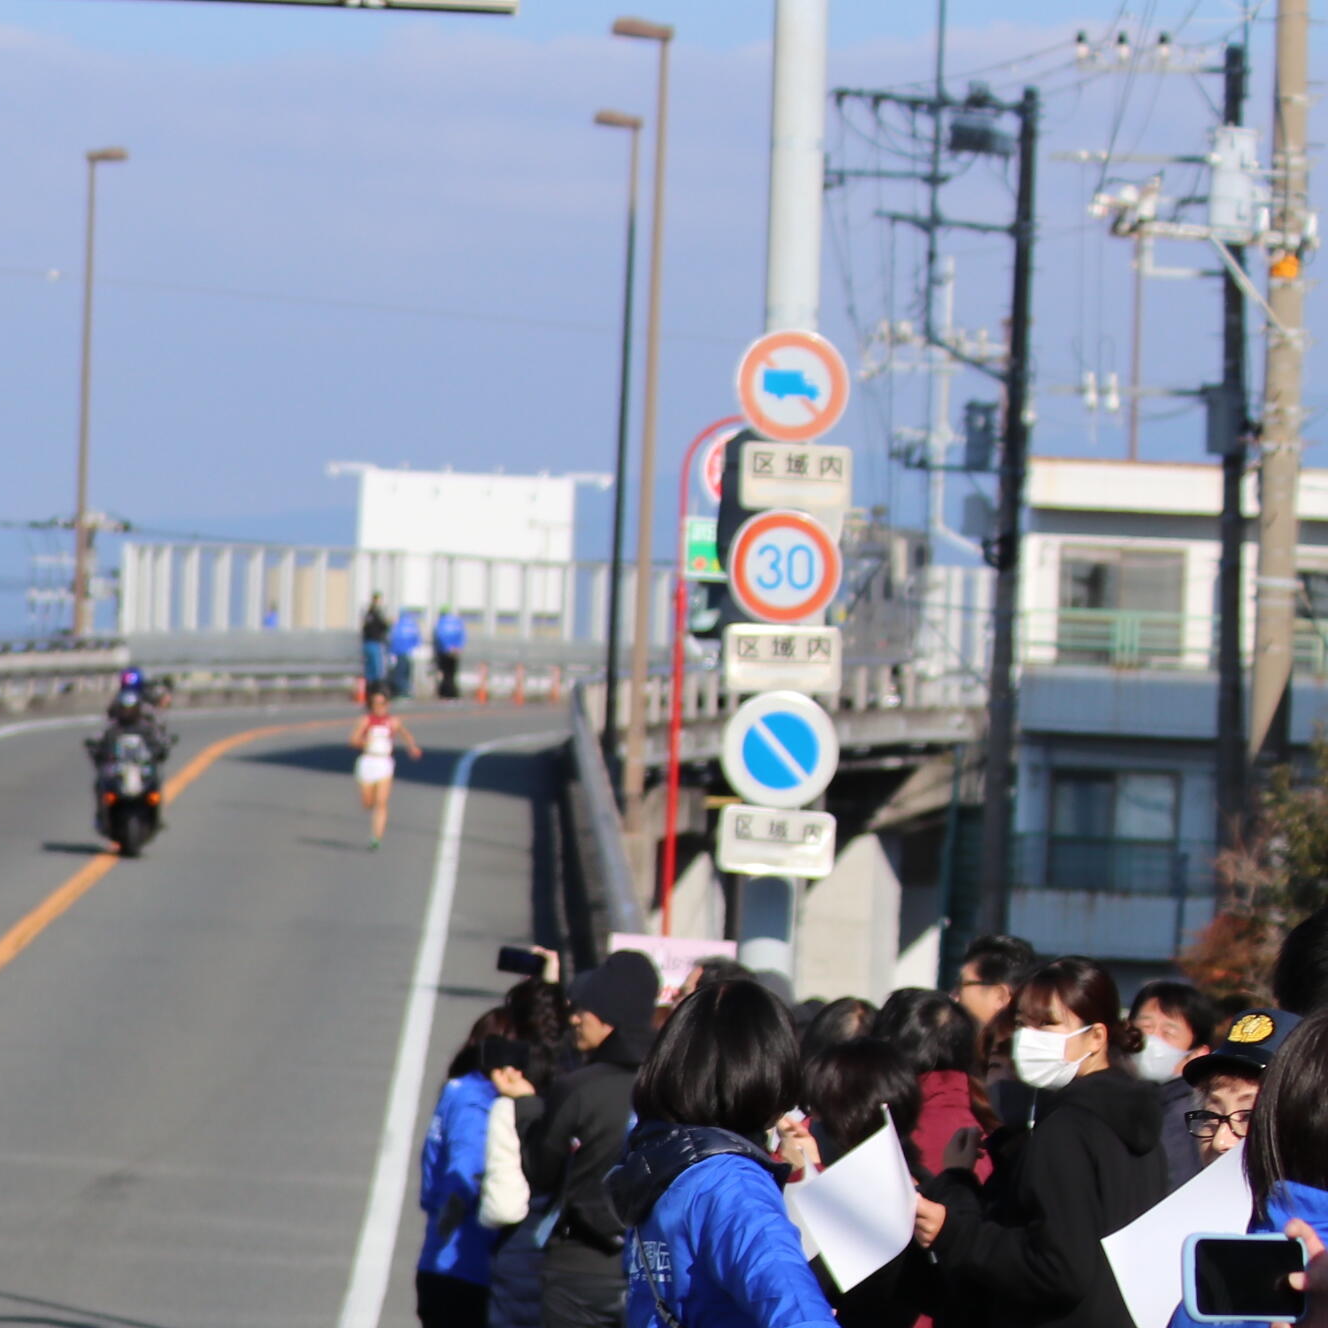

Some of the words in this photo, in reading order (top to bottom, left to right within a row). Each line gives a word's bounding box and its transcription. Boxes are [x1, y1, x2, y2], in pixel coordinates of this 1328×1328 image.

[753, 451, 844, 478] 区域内
[757, 543, 815, 590] 30
[737, 634, 831, 660] 区域内
[735, 814, 823, 844] 区域内
